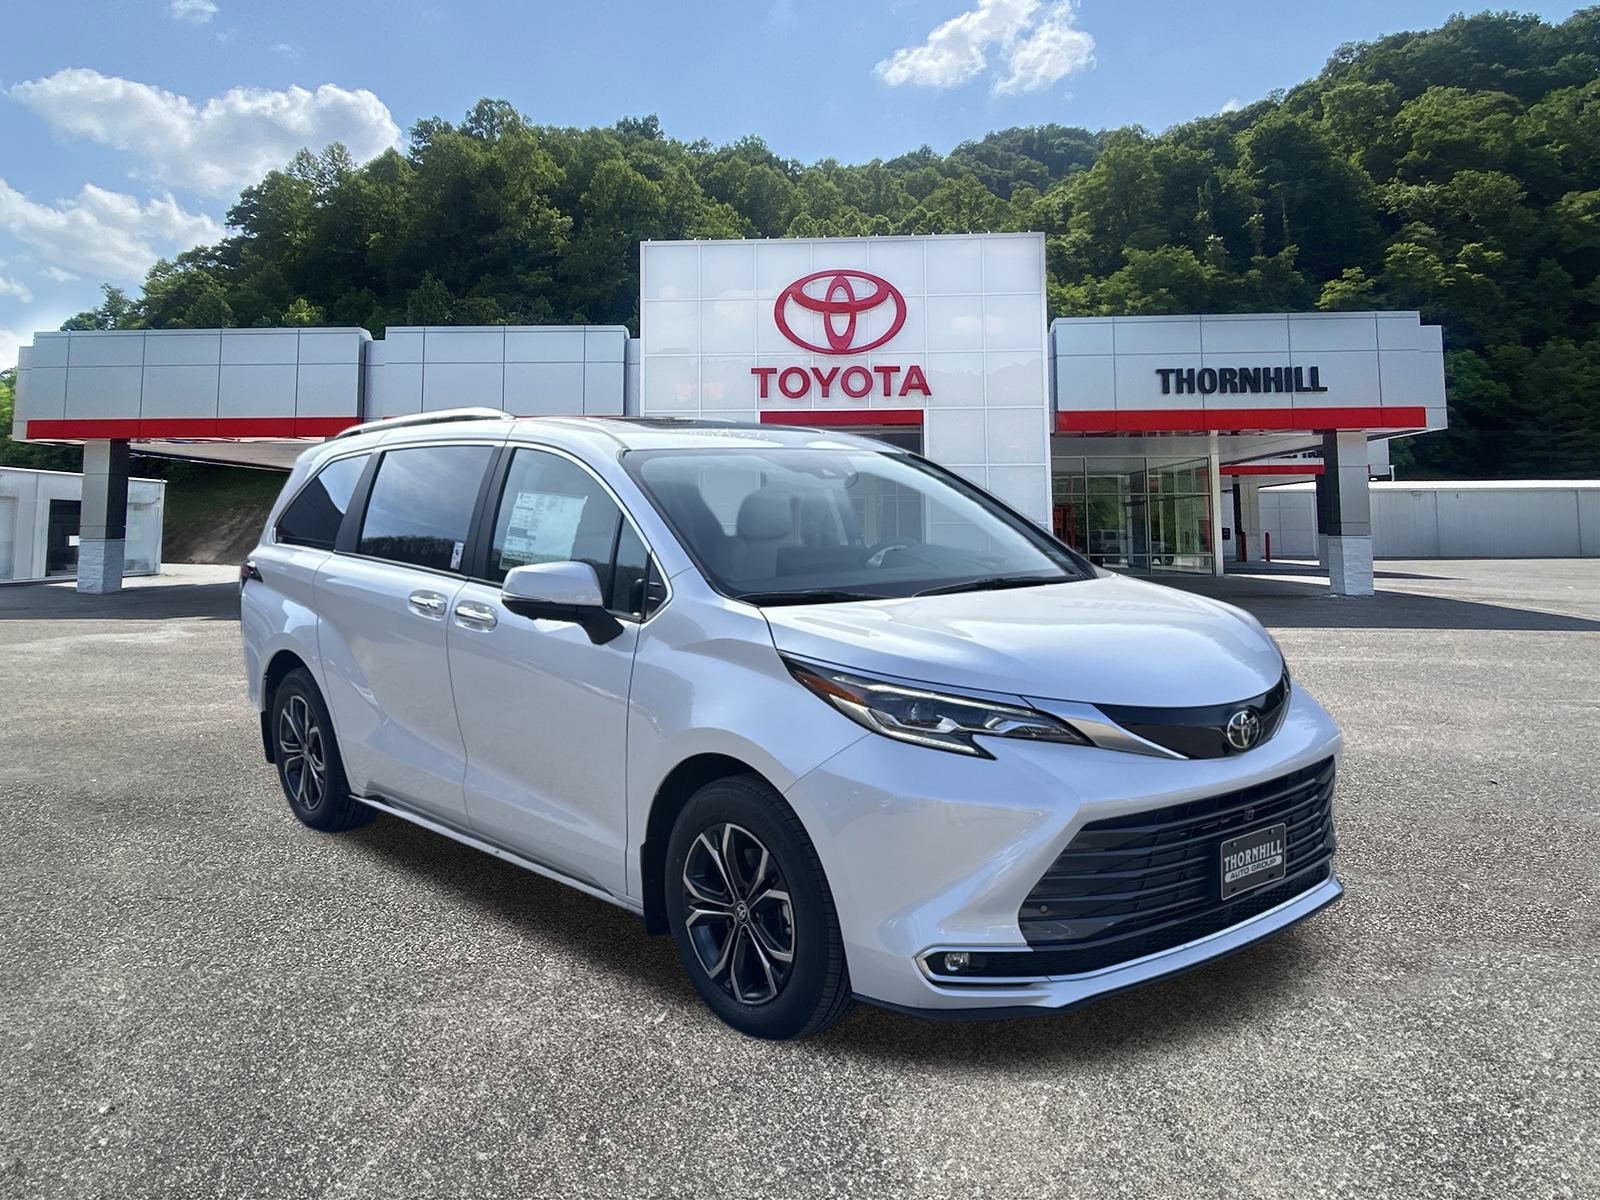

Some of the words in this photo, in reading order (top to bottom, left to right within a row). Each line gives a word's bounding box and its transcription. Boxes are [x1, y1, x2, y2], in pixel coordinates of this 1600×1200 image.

[751, 365, 932, 399] TOYOTA
[1156, 366, 1328, 394] THORNHILL
[1224, 840, 1283, 872] THORNHILL
[1230, 867, 1250, 880] AUTO
[1251, 857, 1277, 872] GROUP
